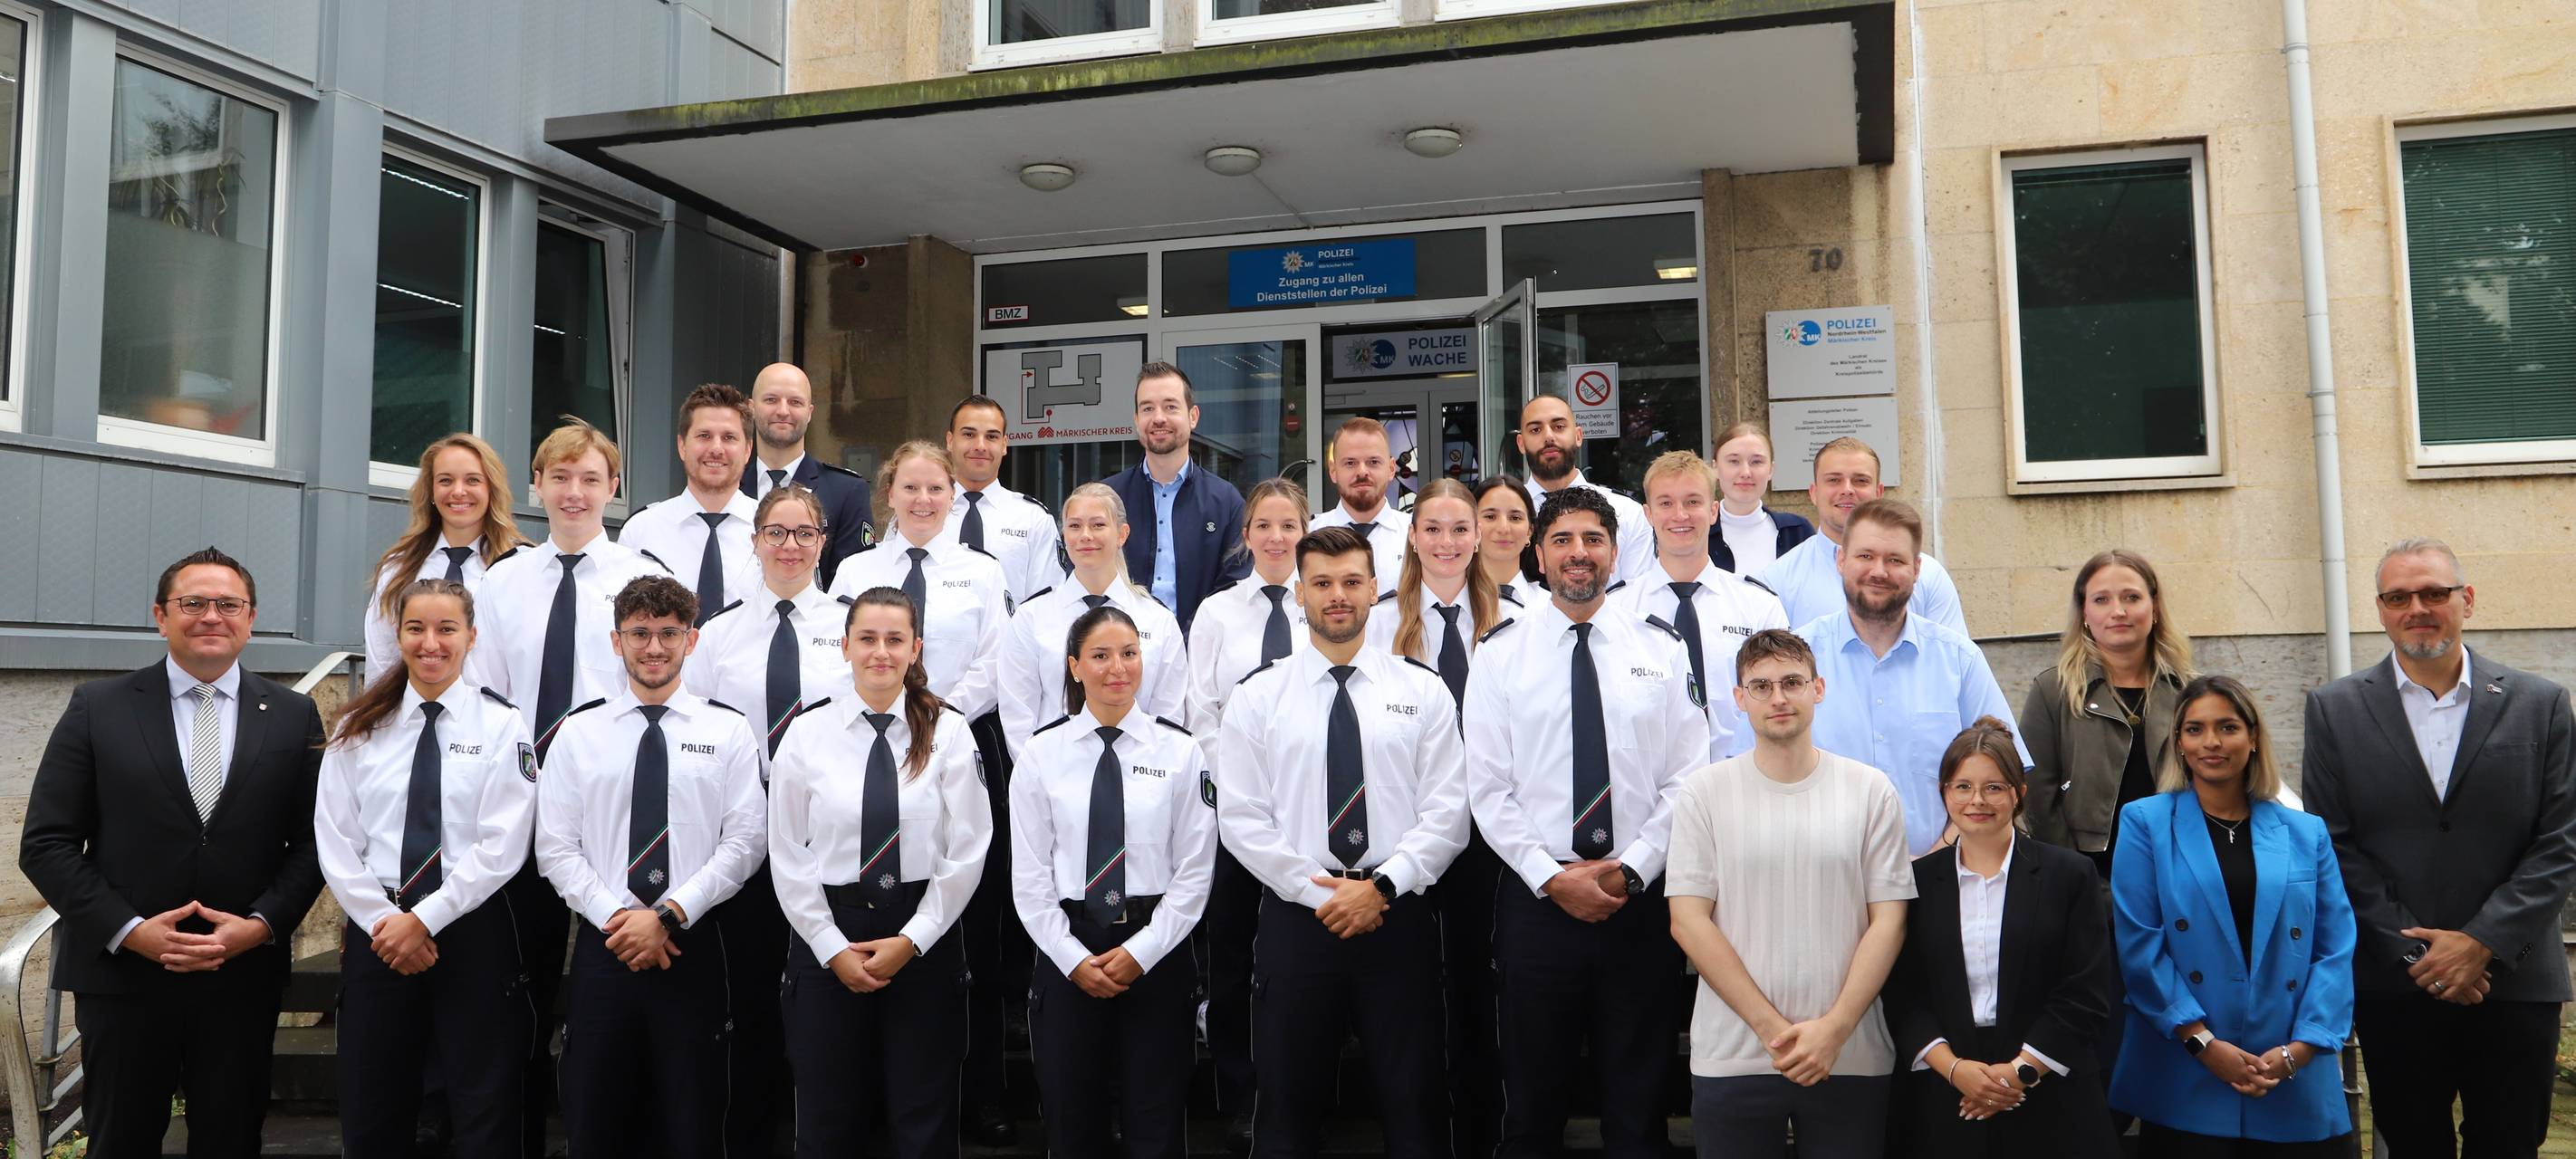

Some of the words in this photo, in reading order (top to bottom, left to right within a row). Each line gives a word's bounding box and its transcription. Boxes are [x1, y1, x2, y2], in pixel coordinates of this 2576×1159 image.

[1318, 248, 1354, 259] POLIZEI
[1278, 277, 1320, 289] Zugang
[1322, 275, 1335, 284] zu
[1339, 273, 1364, 283] allen
[1256, 287, 1327, 302] Dienststellen
[1330, 287, 1349, 298] der
[1350, 283, 1388, 296] Polizei
[995, 309, 1022, 320] BMZ
[1827, 318, 1877, 330] POLIZEI
[1408, 335, 1466, 350] POLIZEI
[1408, 352, 1466, 367] WACHE
[1055, 427, 1108, 437] MÄRKISCHER
[1110, 426, 1133, 436] KREIS
[1001, 528, 1028, 538] POLIZEI
[942, 580, 971, 589] POLIZEI
[1722, 625, 1754, 637] POLIZEI
[812, 637, 841, 647] POLIZE
[1631, 667, 1664, 679] POLIZEI
[1386, 704, 1418, 715] POLIZEI
[449, 743, 482, 754] POLIZEI
[681, 743, 715, 754] POLIZEI
[1133, 766, 1166, 778] POLIZEI
